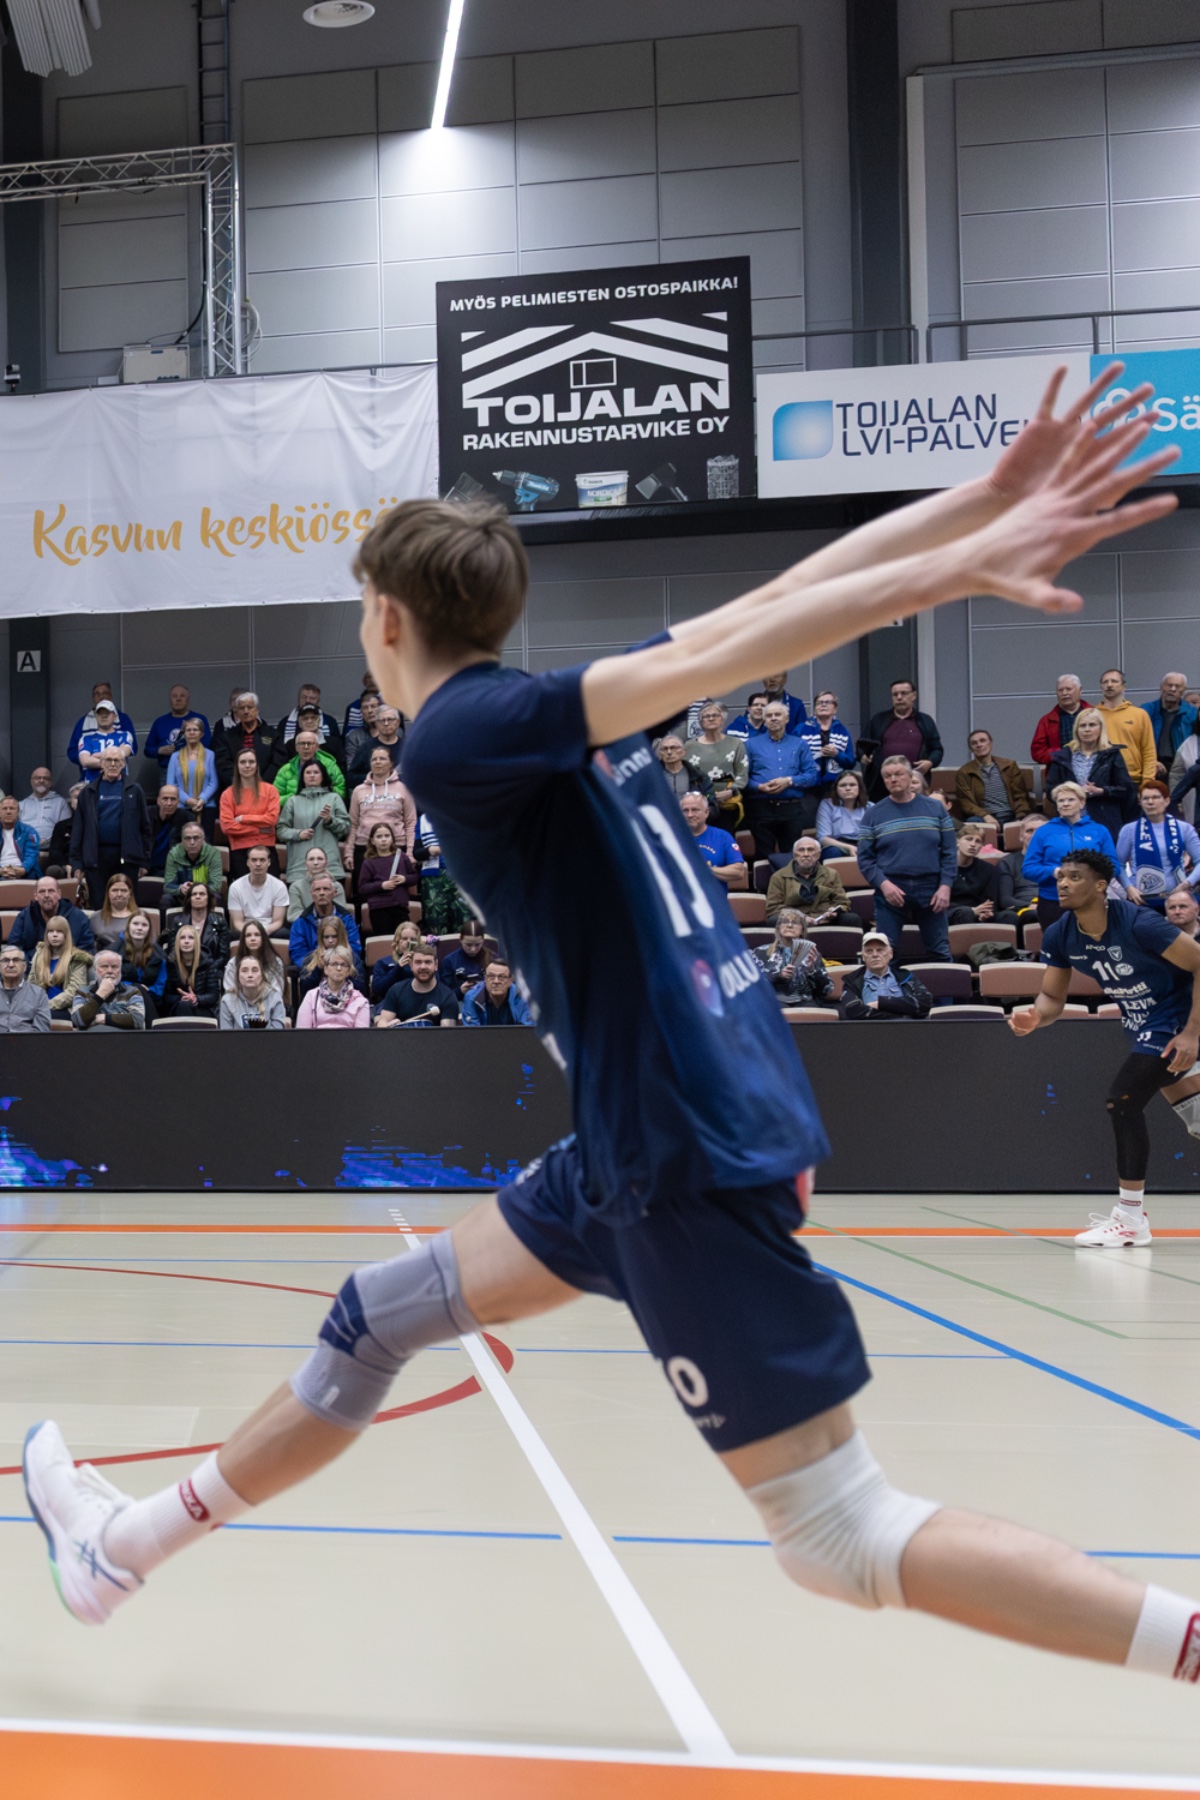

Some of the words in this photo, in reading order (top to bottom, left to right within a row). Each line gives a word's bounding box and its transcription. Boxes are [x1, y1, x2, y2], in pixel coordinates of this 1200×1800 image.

[450, 295, 497, 312] MYÖS
[501, 287, 610, 308] PELIMIESTEN
[615, 276, 739, 300] OSTOSPAIKKA!
[462, 380, 731, 428] TOIJALAN
[836, 393, 997, 430] TOIJALAN
[462, 419, 691, 451] RAKENNUSTARVIKE
[696, 416, 730, 434] OY
[843, 419, 1028, 457] LVI-PALVE
[33, 503, 184, 567] Kasvun
[20, 651, 36, 671] A
